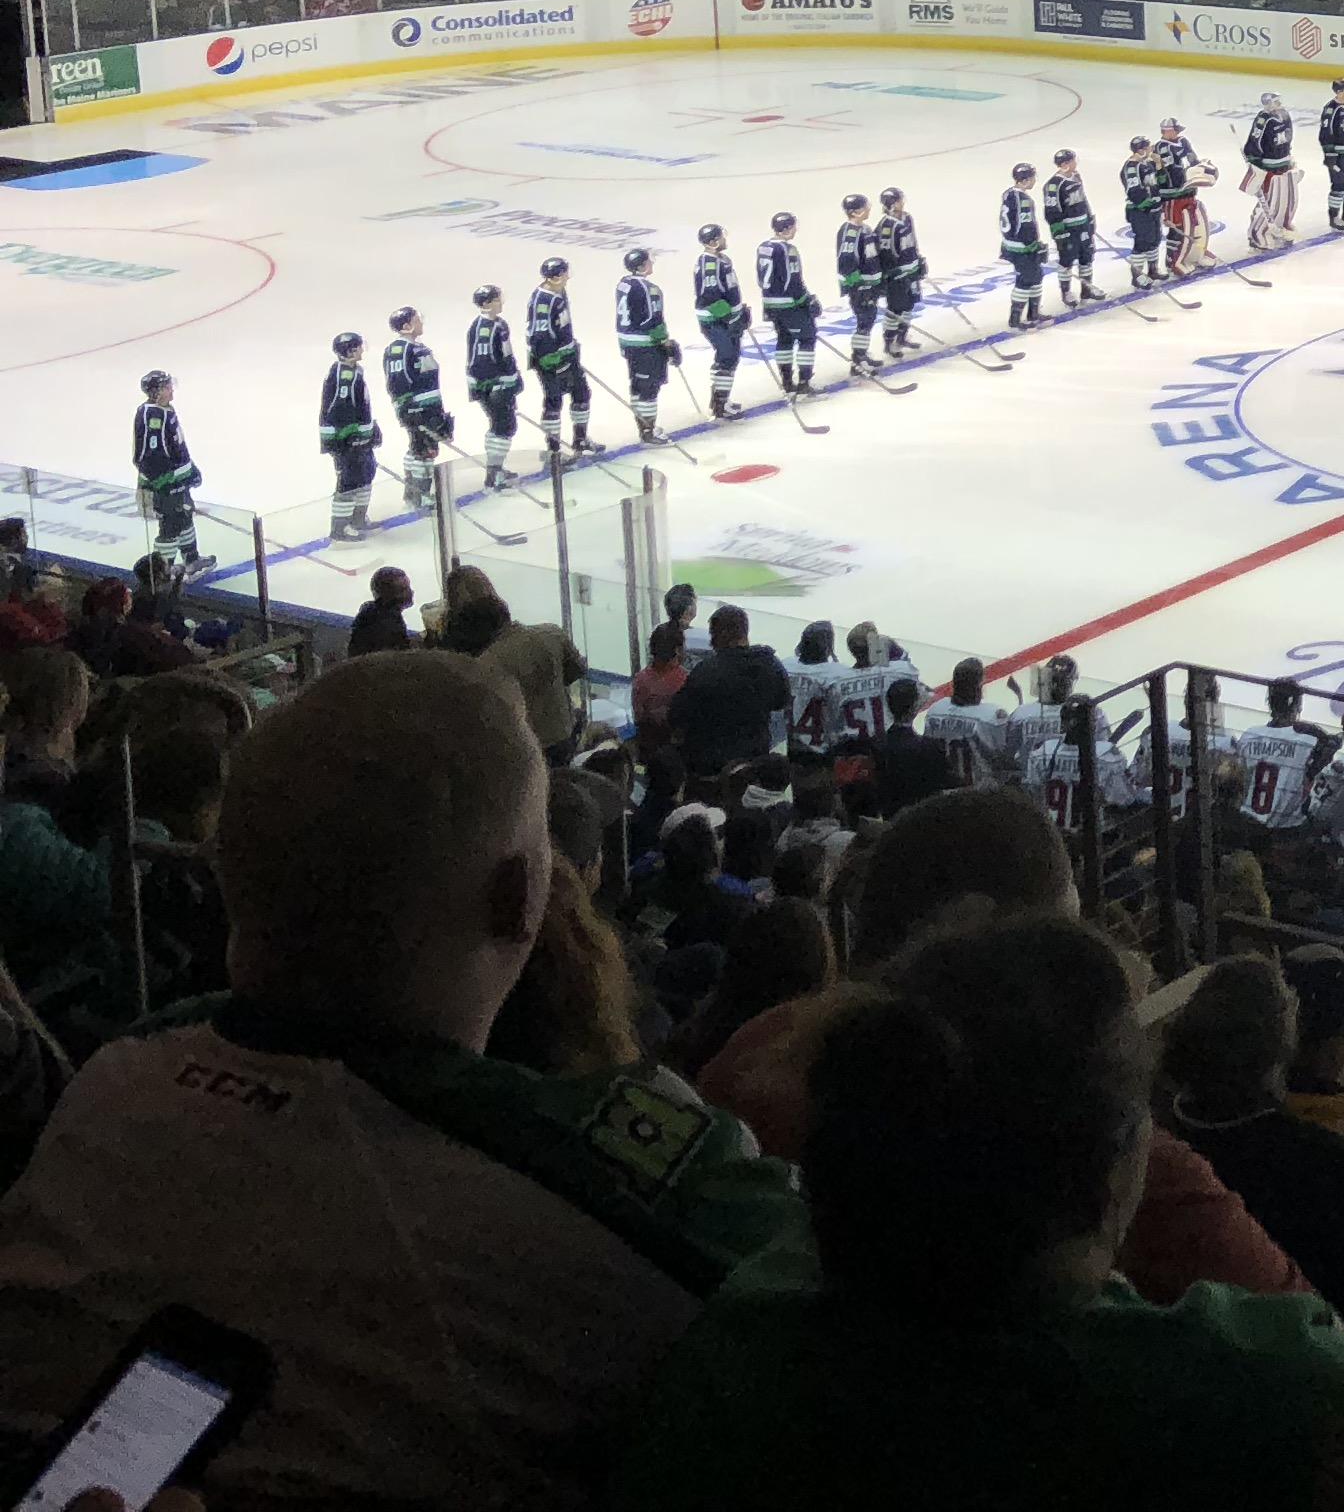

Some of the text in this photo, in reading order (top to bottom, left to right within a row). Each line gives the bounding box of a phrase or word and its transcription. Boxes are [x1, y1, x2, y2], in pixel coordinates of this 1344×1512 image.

[431, 5, 576, 33] Consolidated
[908, 4, 955, 21] RMS
[432, 26, 576, 46] communications
[1193, 13, 1272, 48] CROSS
[251, 33, 318, 62] pepsi
[51, 56, 103, 85] reen
[1252, 760, 1280, 816] 8
[175, 1061, 293, 1114] CCM
